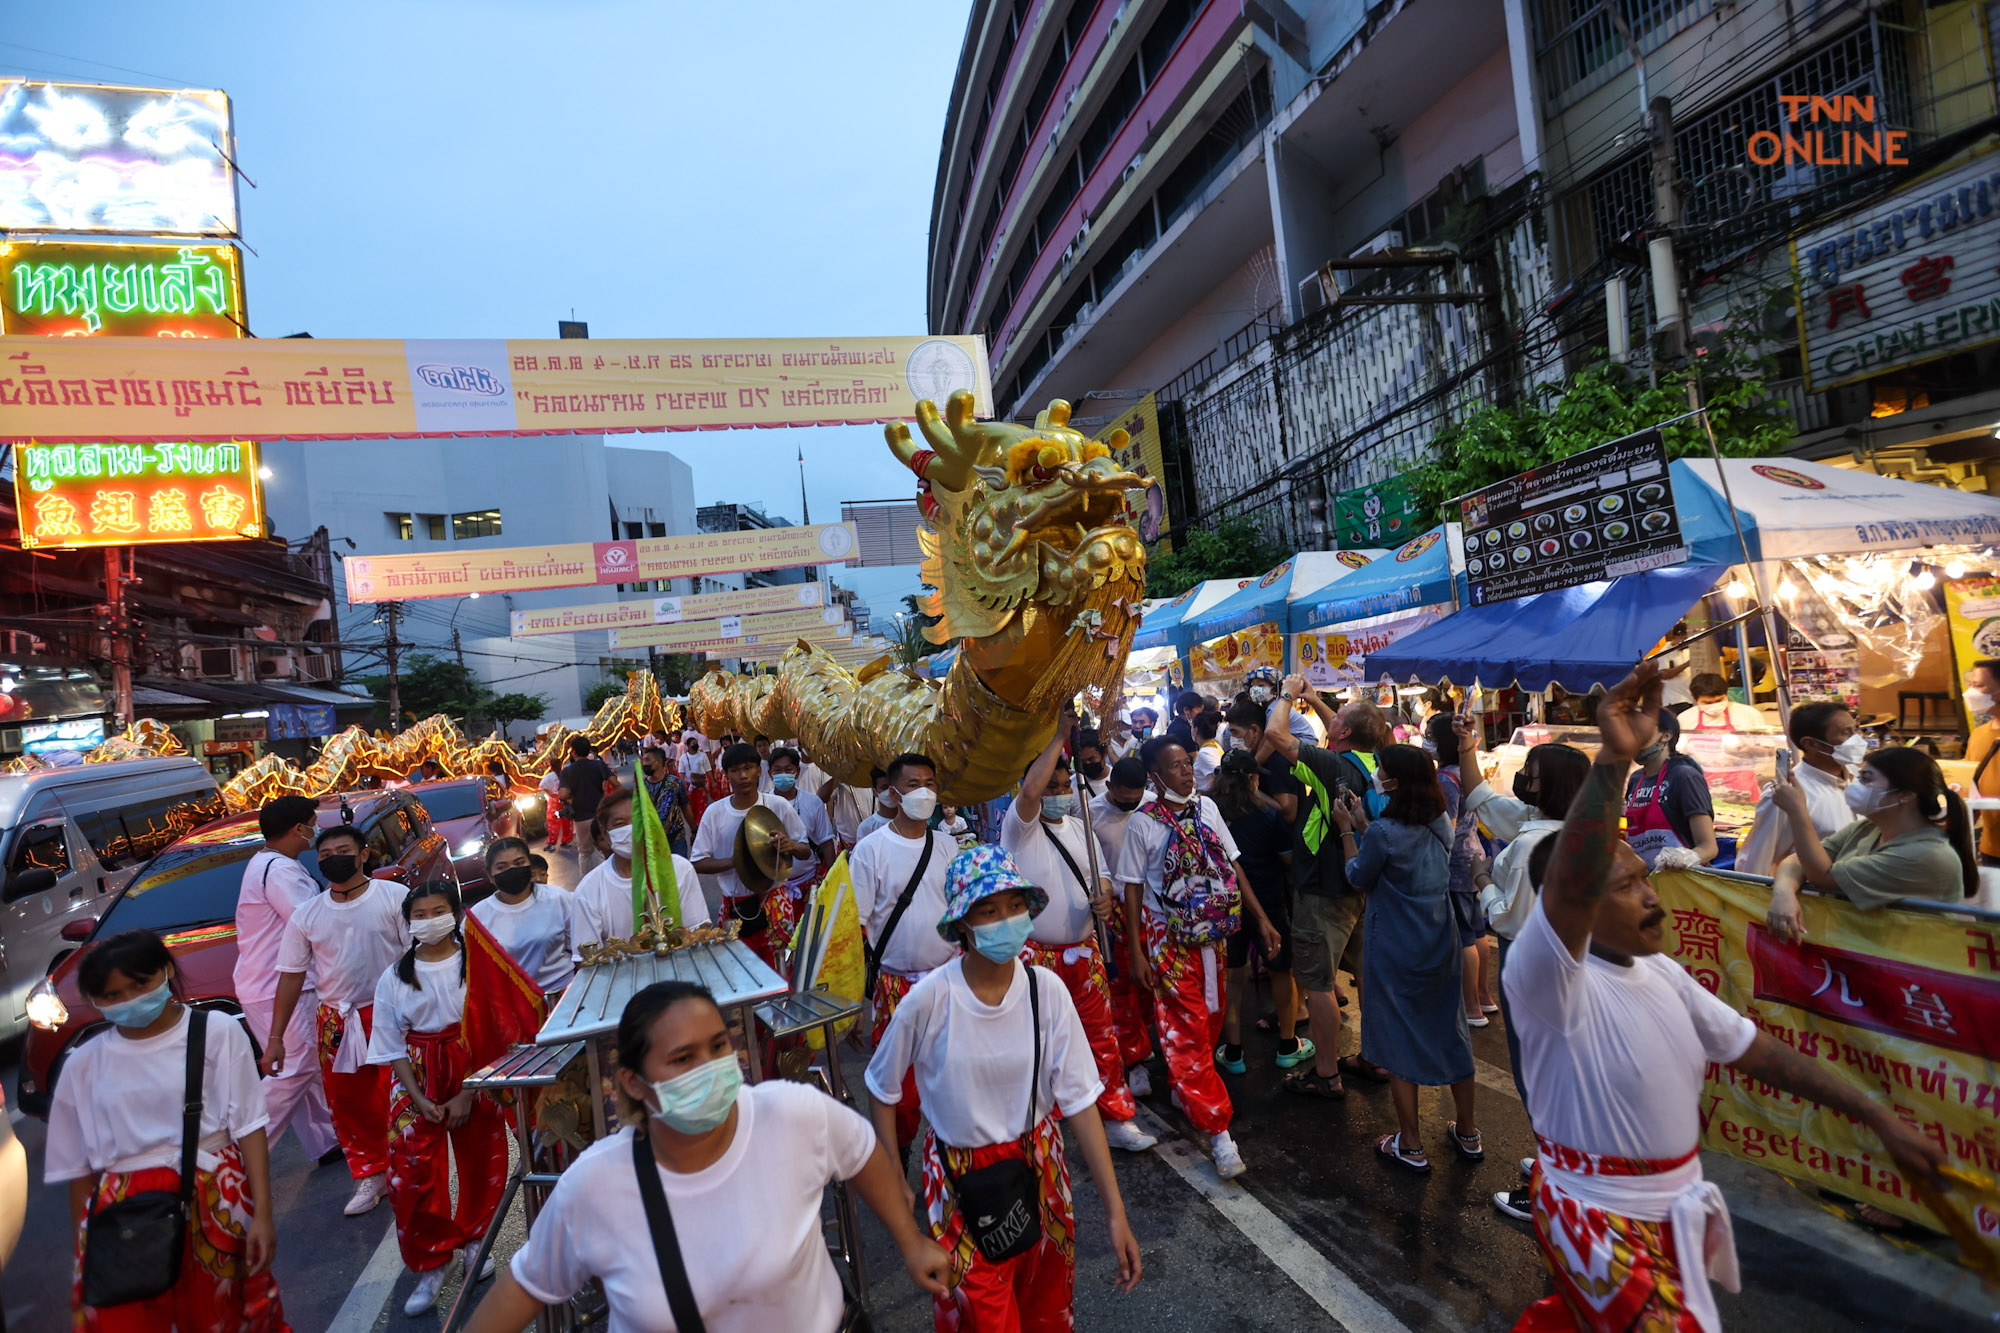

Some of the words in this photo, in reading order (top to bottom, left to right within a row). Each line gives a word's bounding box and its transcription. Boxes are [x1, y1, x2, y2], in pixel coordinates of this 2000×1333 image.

[12, 246, 227, 333] หมุยเล้ง
[25, 443, 241, 491] หูฉลาม-รงนก
[1544, 572, 1605, 591] 088-743-2897
[981, 1199, 1030, 1259] NIKE
